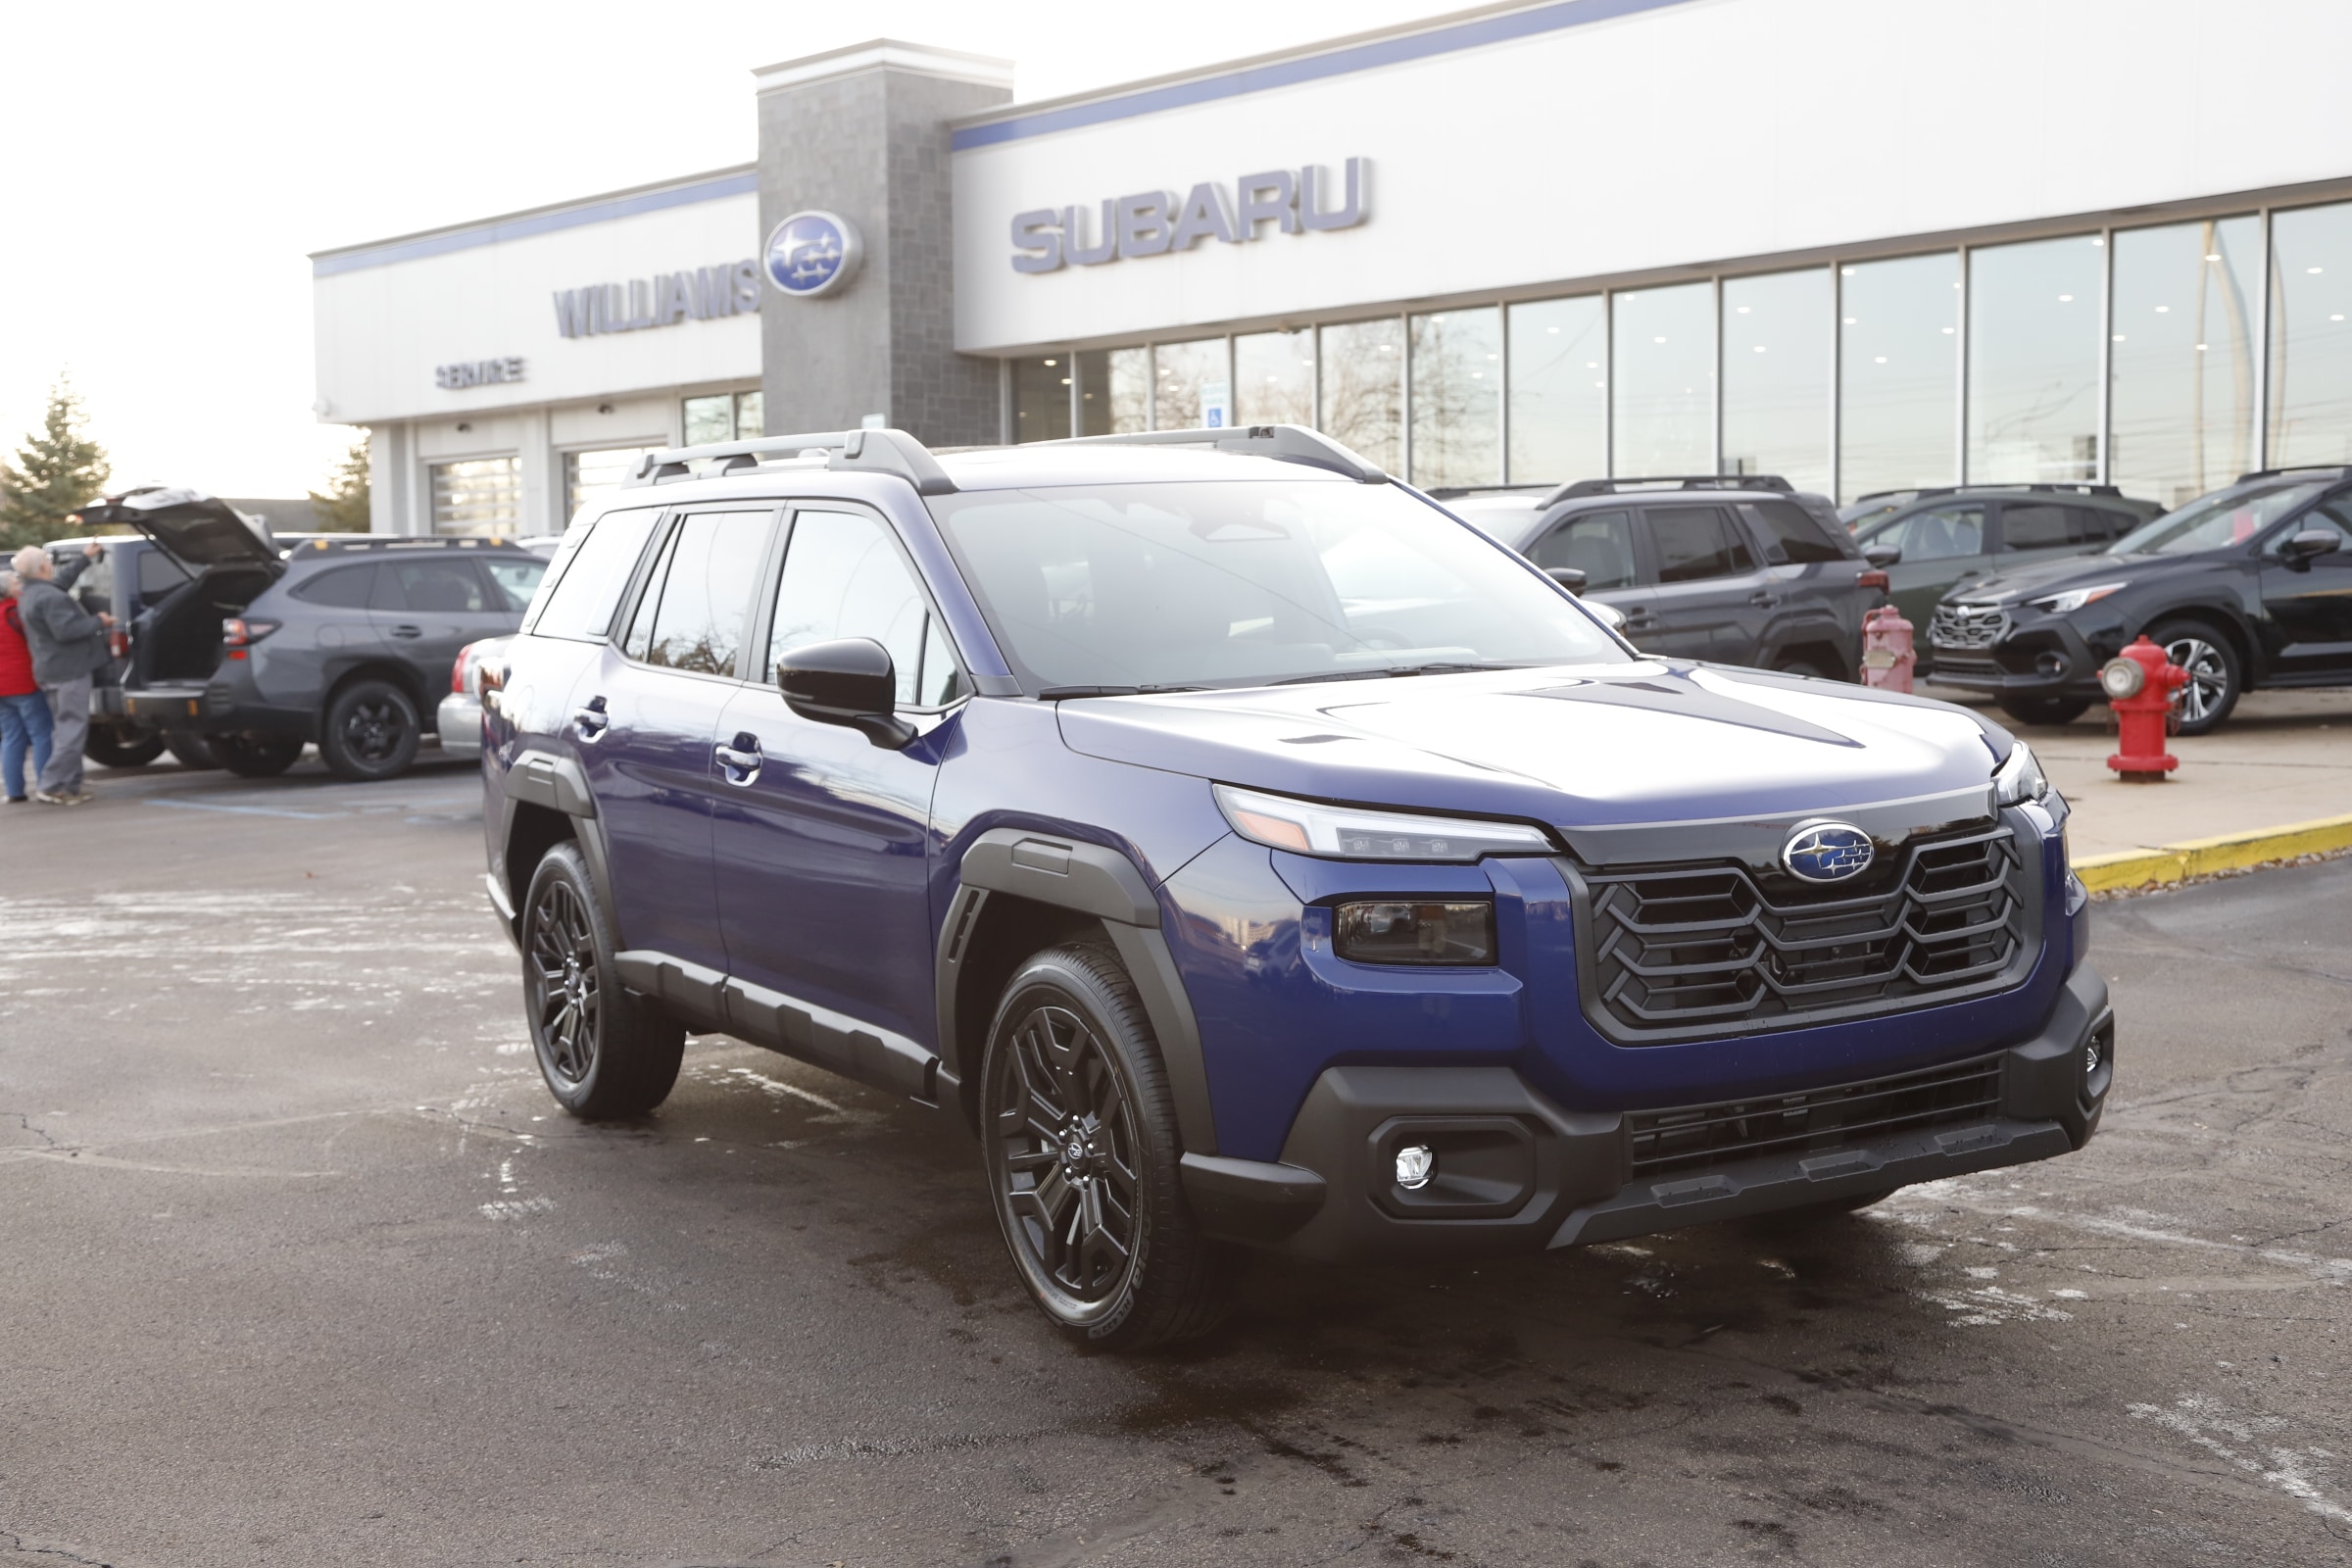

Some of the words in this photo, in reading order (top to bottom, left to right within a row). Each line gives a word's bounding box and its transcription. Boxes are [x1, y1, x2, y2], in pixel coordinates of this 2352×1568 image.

[1011, 157, 1368, 274] SUBARU
[554, 258, 761, 338] WILLIAMS
[435, 356, 525, 389] SERVICE
